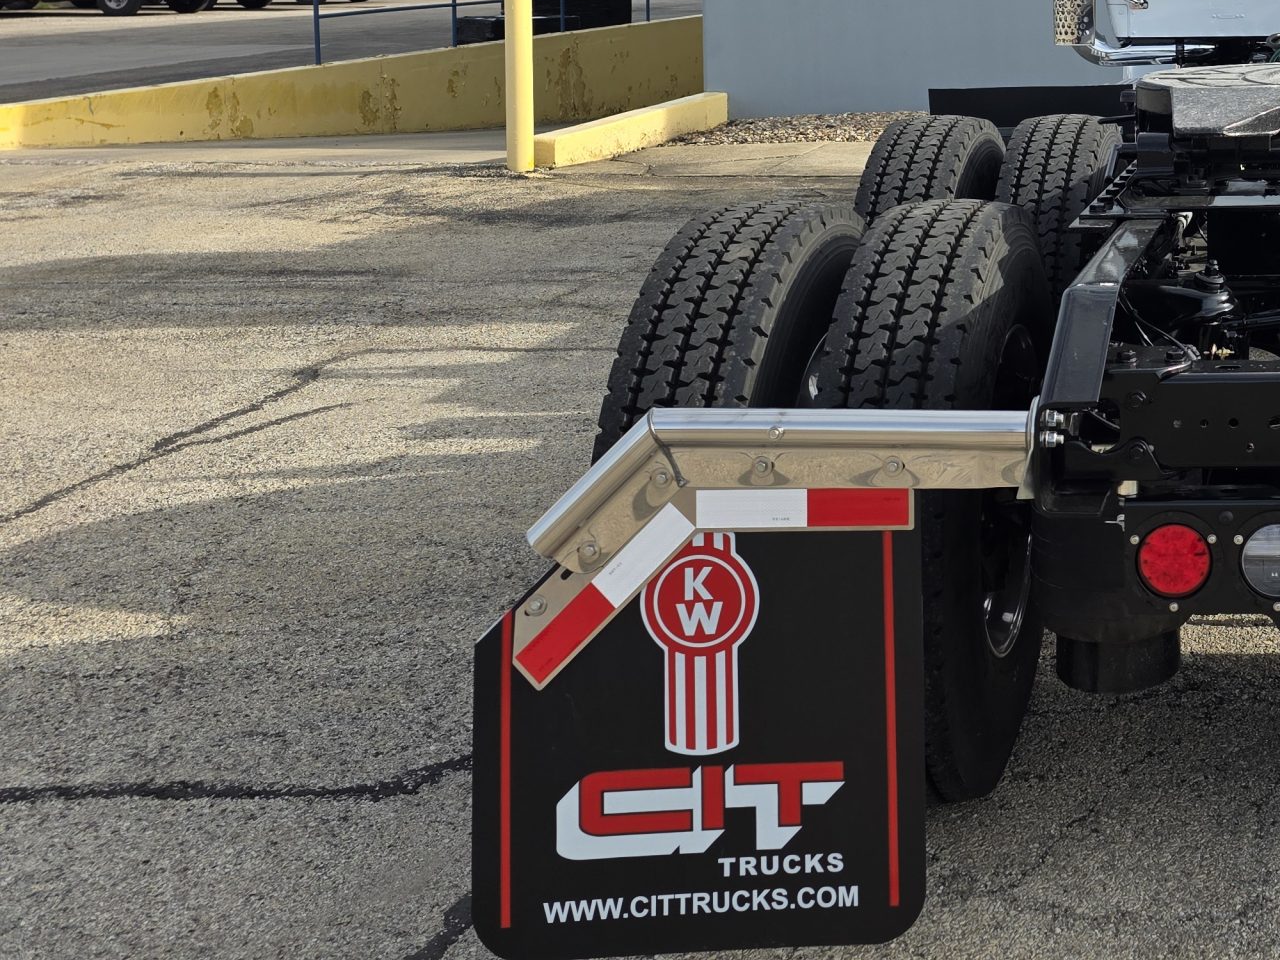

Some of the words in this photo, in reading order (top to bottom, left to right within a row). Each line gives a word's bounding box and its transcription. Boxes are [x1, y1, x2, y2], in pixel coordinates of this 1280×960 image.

[577, 761, 845, 837] CIT
[717, 852, 845, 878] TRUCKS
[543, 884, 860, 924] WWW.CITTRUCKS.COM
